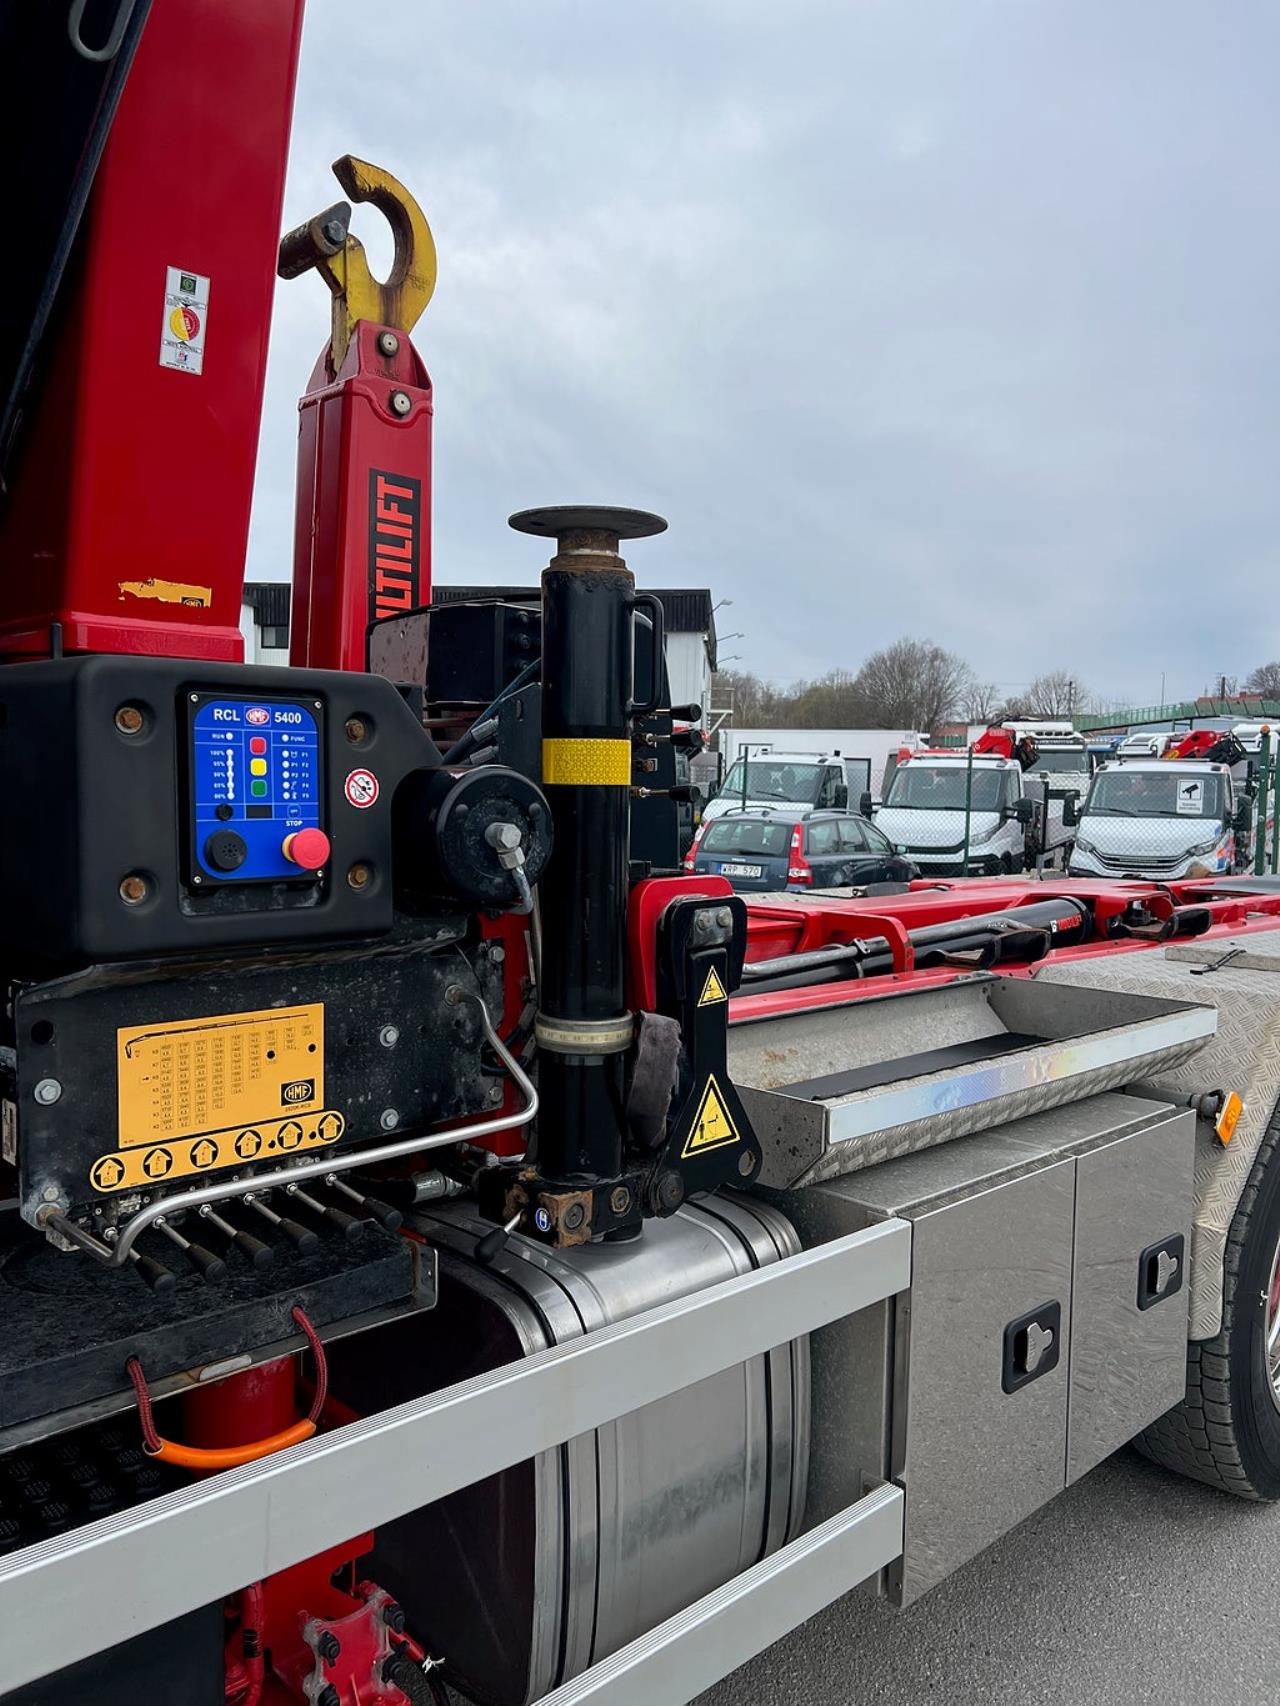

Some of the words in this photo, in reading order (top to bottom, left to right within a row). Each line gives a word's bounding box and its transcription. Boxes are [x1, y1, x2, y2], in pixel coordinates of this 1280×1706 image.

[213, 708, 241, 721] RCL
[274, 711, 302, 724] 5400
[743, 866, 759, 876] 570
[287, 1084, 309, 1100] HMF
